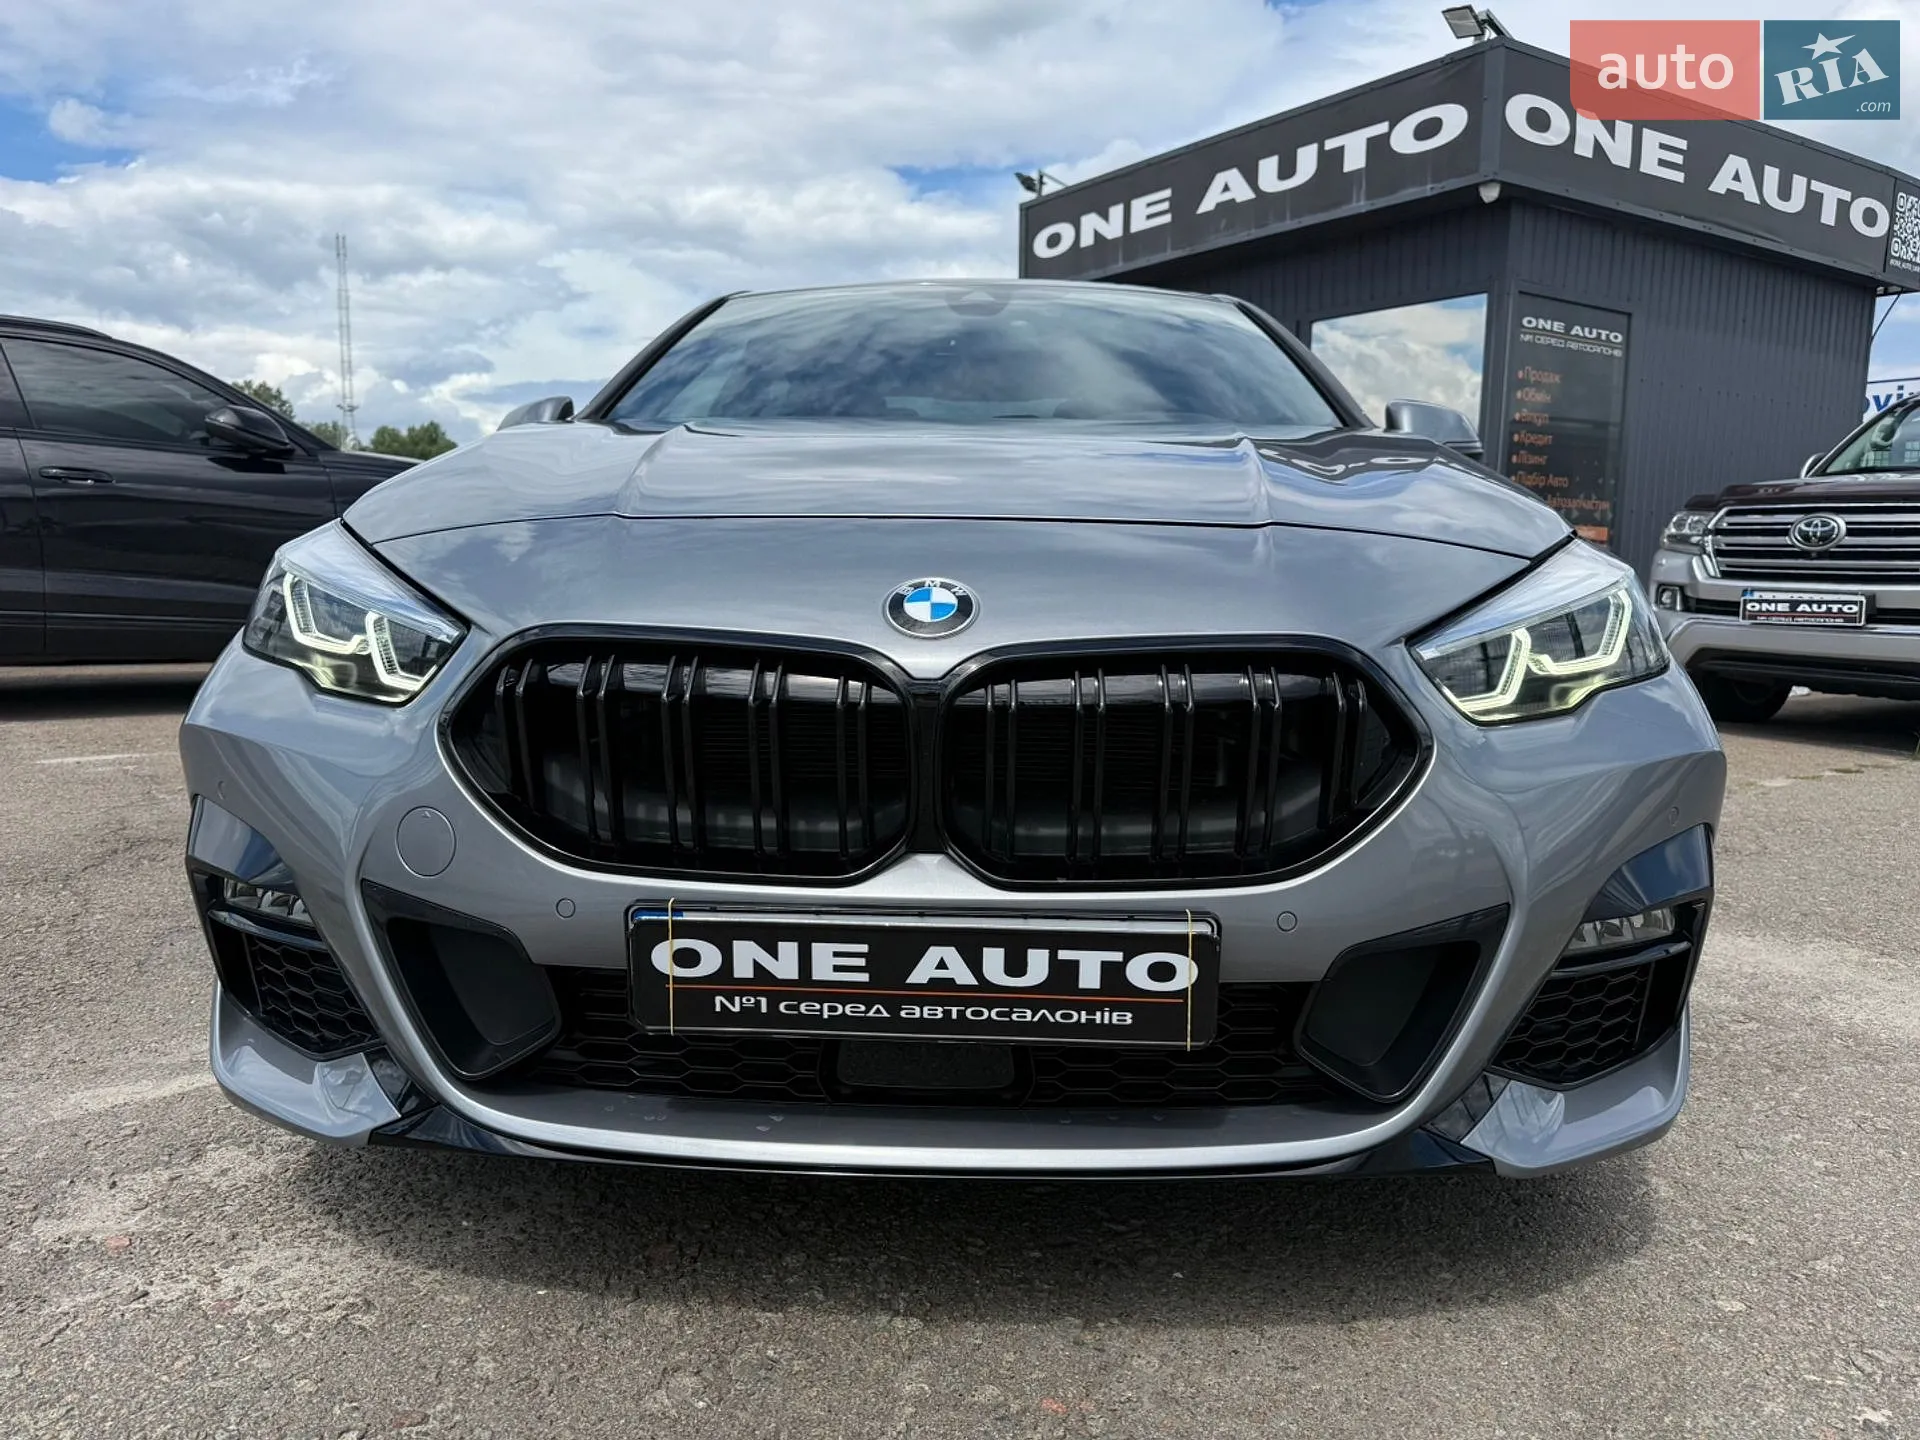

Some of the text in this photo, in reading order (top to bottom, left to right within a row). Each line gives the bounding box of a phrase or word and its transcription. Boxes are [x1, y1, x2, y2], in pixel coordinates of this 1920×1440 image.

[1032, 103, 1469, 259] ONE AUTO
[1504, 93, 1891, 239] ONE AUTO
[1522, 316, 1623, 343] ONE AUTO
[896, 579, 968, 596] BMW
[1746, 602, 1858, 613] ONE AUTO
[650, 938, 1199, 992] ONE AUTO
[714, 995, 1133, 1026] №1 серед автосалонів
